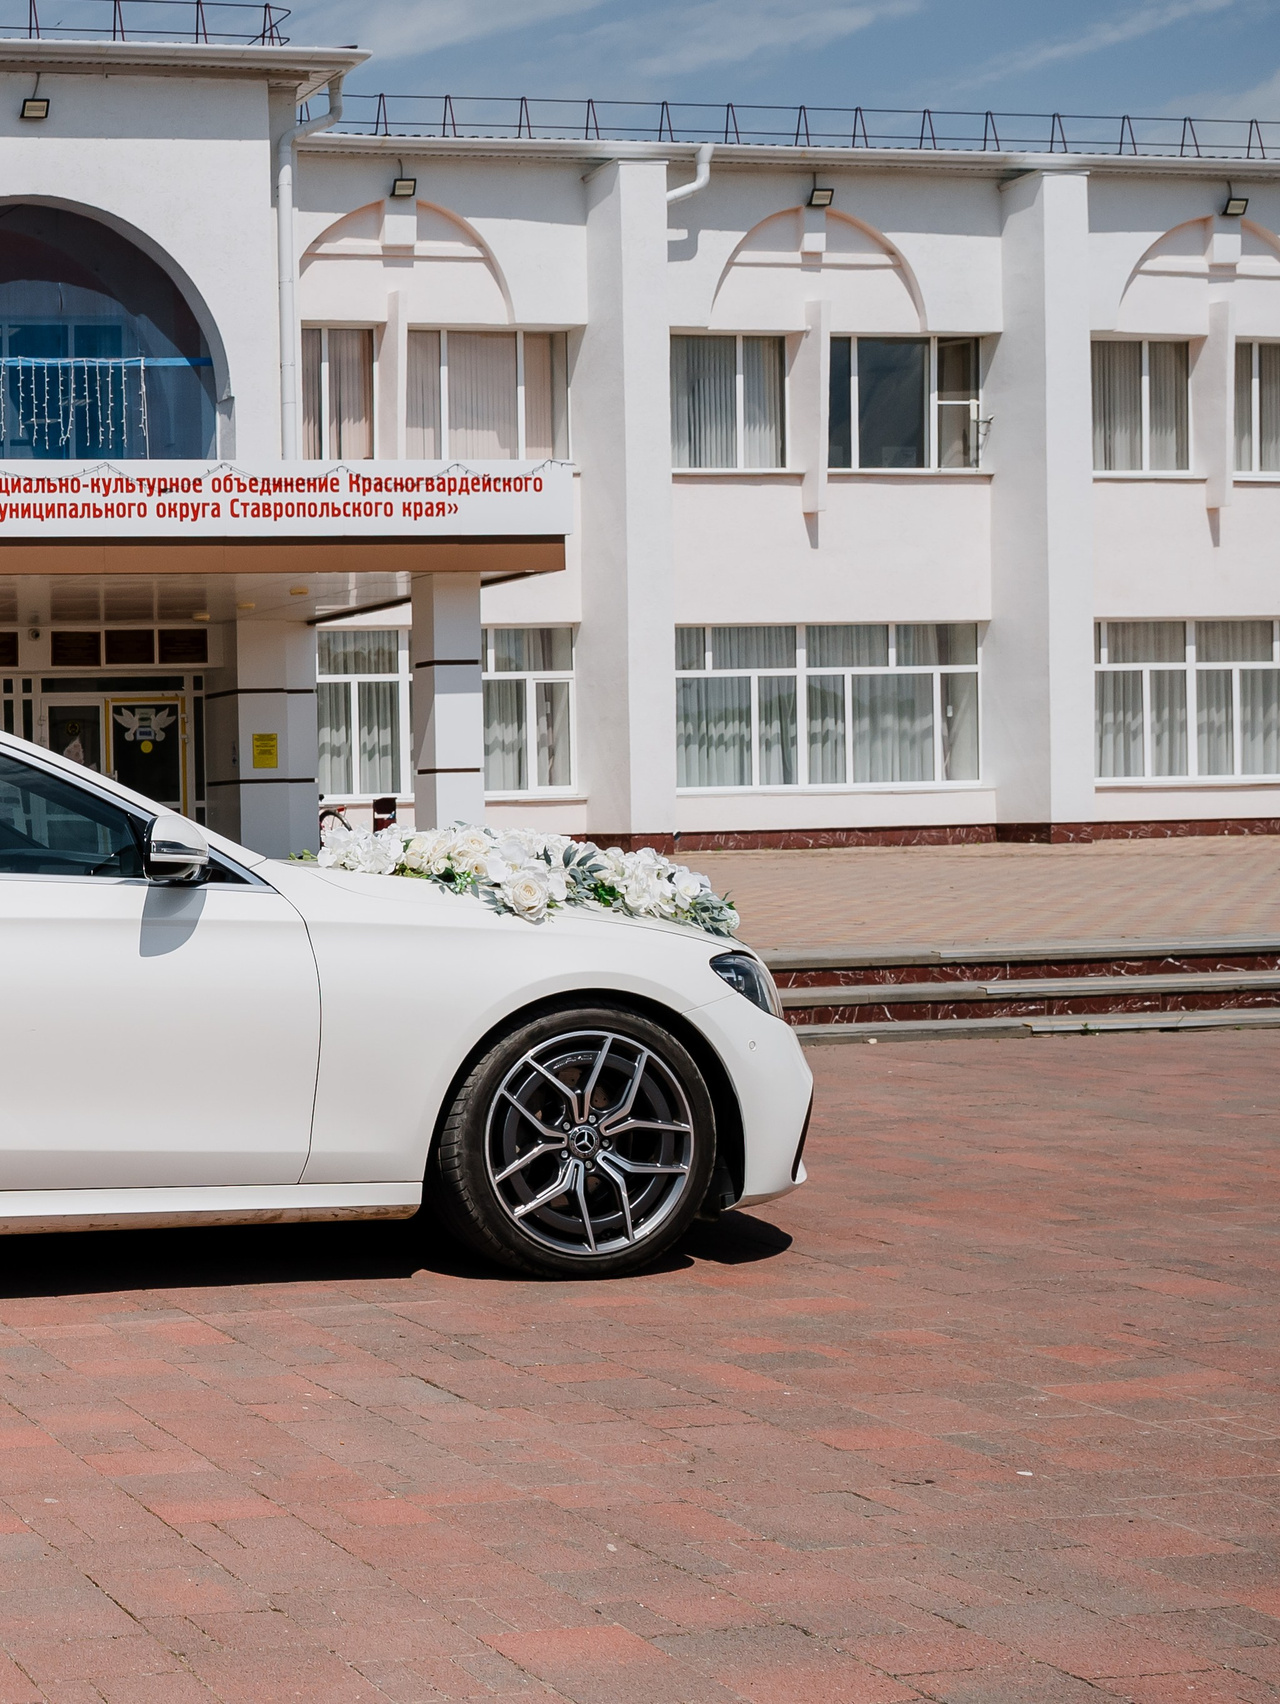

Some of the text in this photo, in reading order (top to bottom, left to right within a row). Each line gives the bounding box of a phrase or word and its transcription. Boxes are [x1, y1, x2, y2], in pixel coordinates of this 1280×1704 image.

[211, 473, 340, 497] объединение
[348, 473, 543, 496] Красногвардейского
[155, 501, 221, 522] округа
[229, 498, 394, 521] Ставропольского
[401, 501, 459, 521] края»
